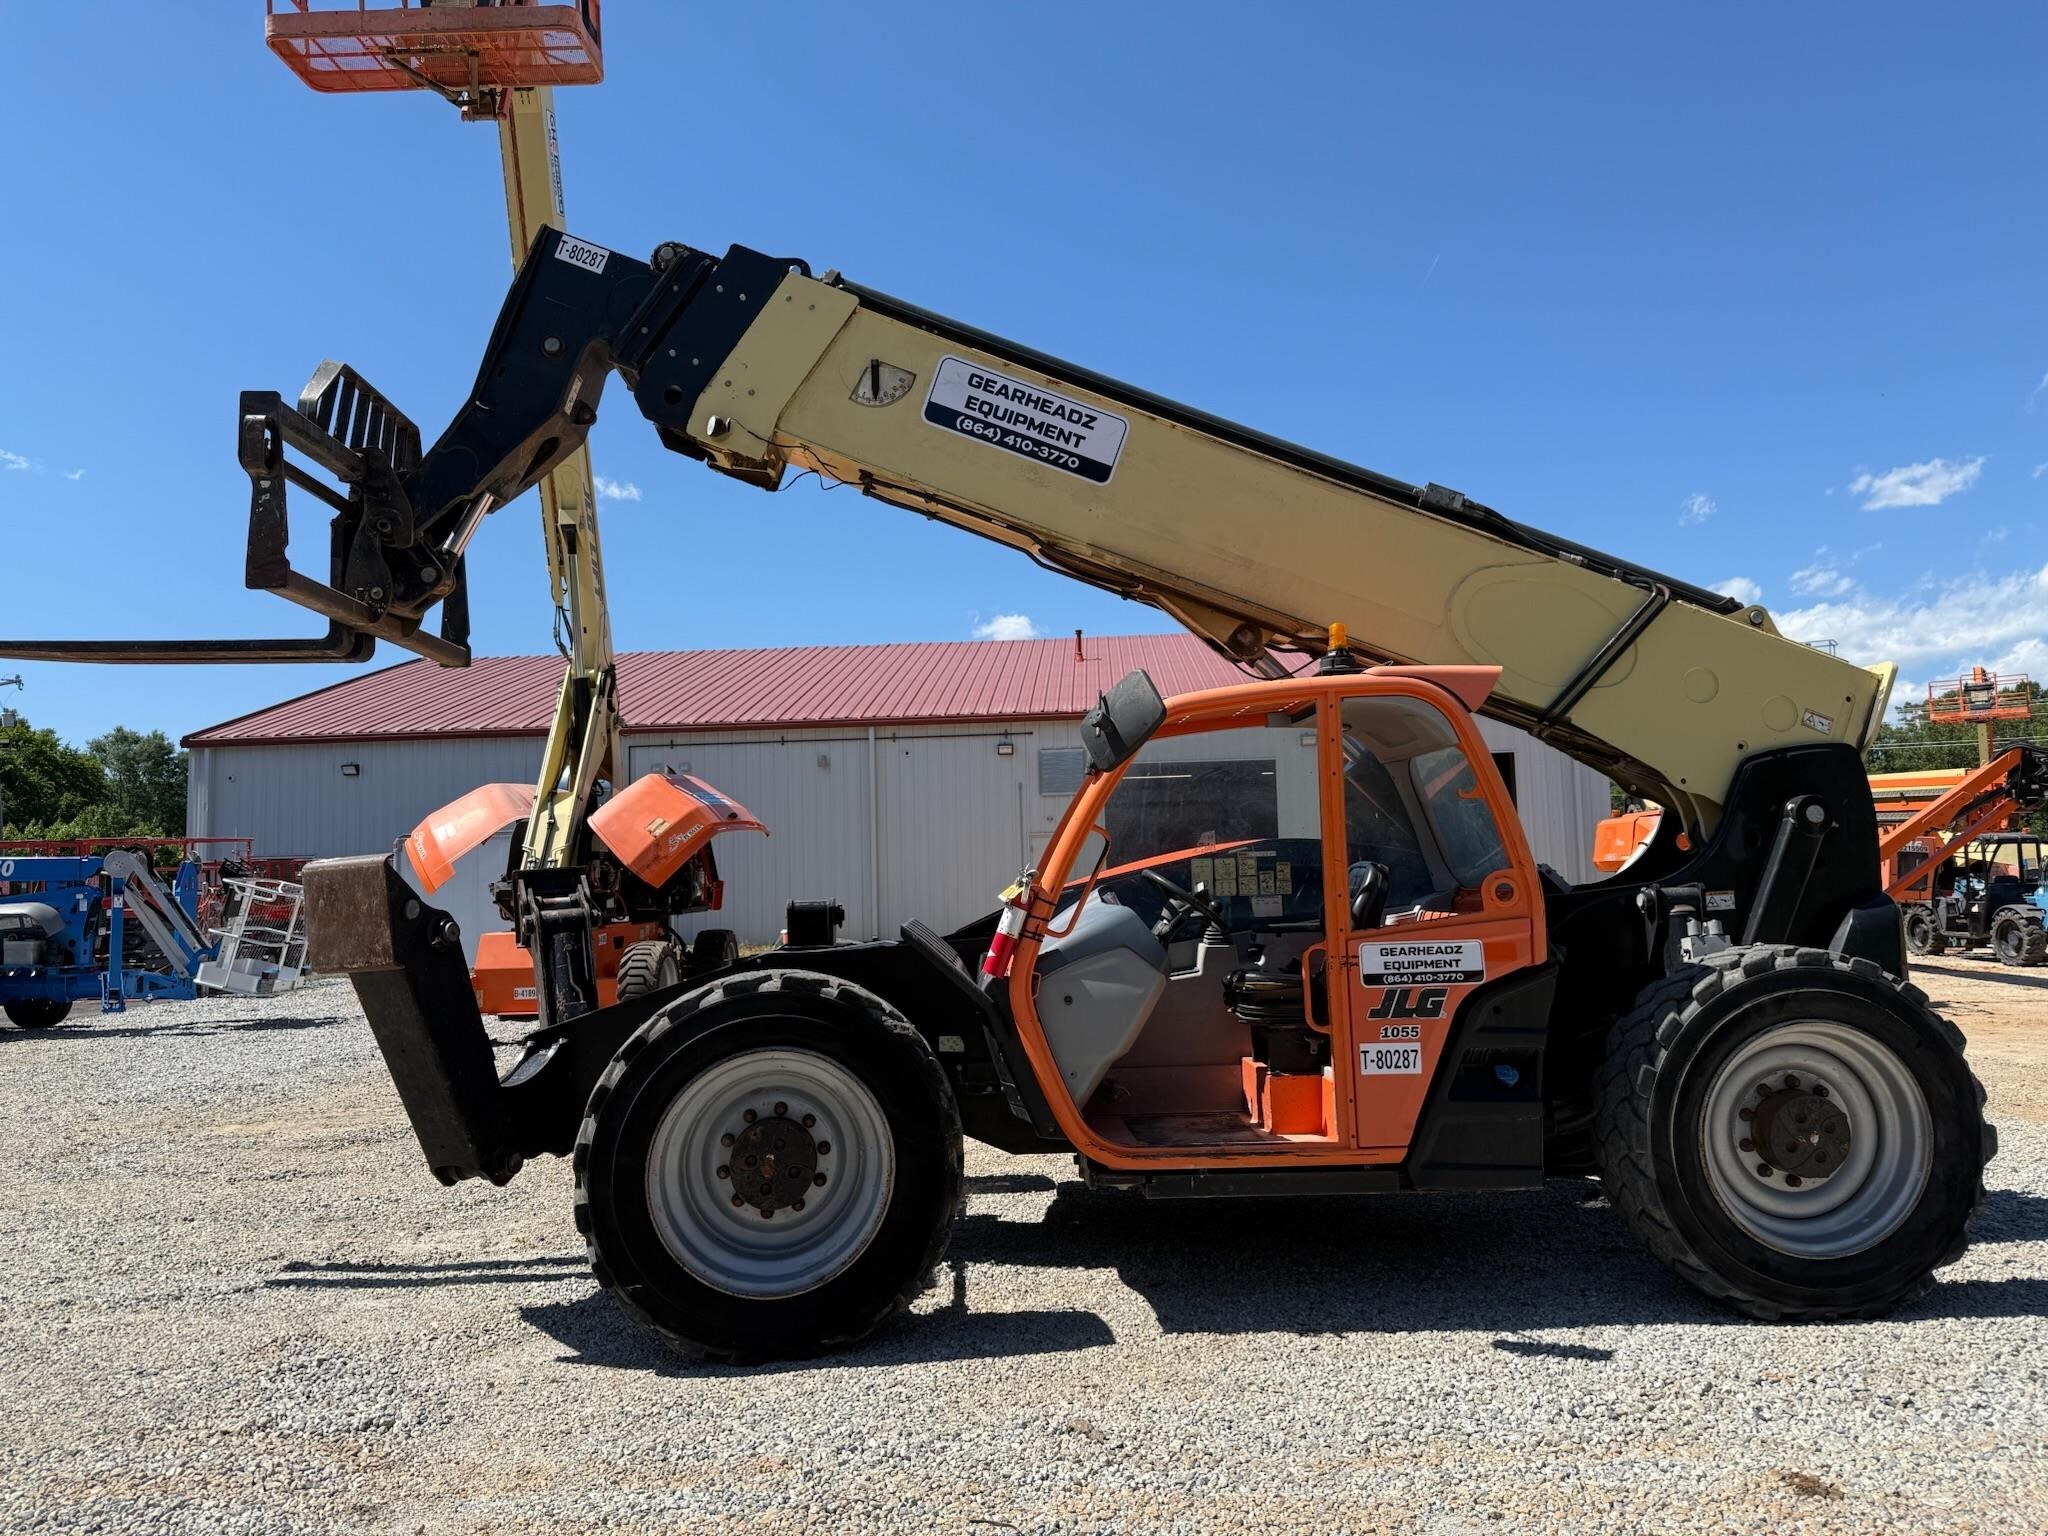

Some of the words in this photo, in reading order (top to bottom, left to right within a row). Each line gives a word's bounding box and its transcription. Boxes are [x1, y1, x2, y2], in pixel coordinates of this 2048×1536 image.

[559, 240, 606, 269] T-80287
[967, 372, 1098, 430] GEARHEADZ
[964, 394, 1087, 449] EQUIPMENT
[956, 415, 1001, 442] (864)
[1003, 434, 1080, 468] 410-3770
[0, 860, 15, 877] 0
[1380, 945, 1463, 957] GEARHEADZ
[1384, 959, 1462, 971] EQUIPMENT
[1383, 973, 1412, 984] (864)
[1415, 973, 1464, 982] 410-3770
[1367, 987, 1449, 1019] JLG
[1380, 1025, 1420, 1039] 1055
[1360, 1049, 1419, 1070] T-80287
